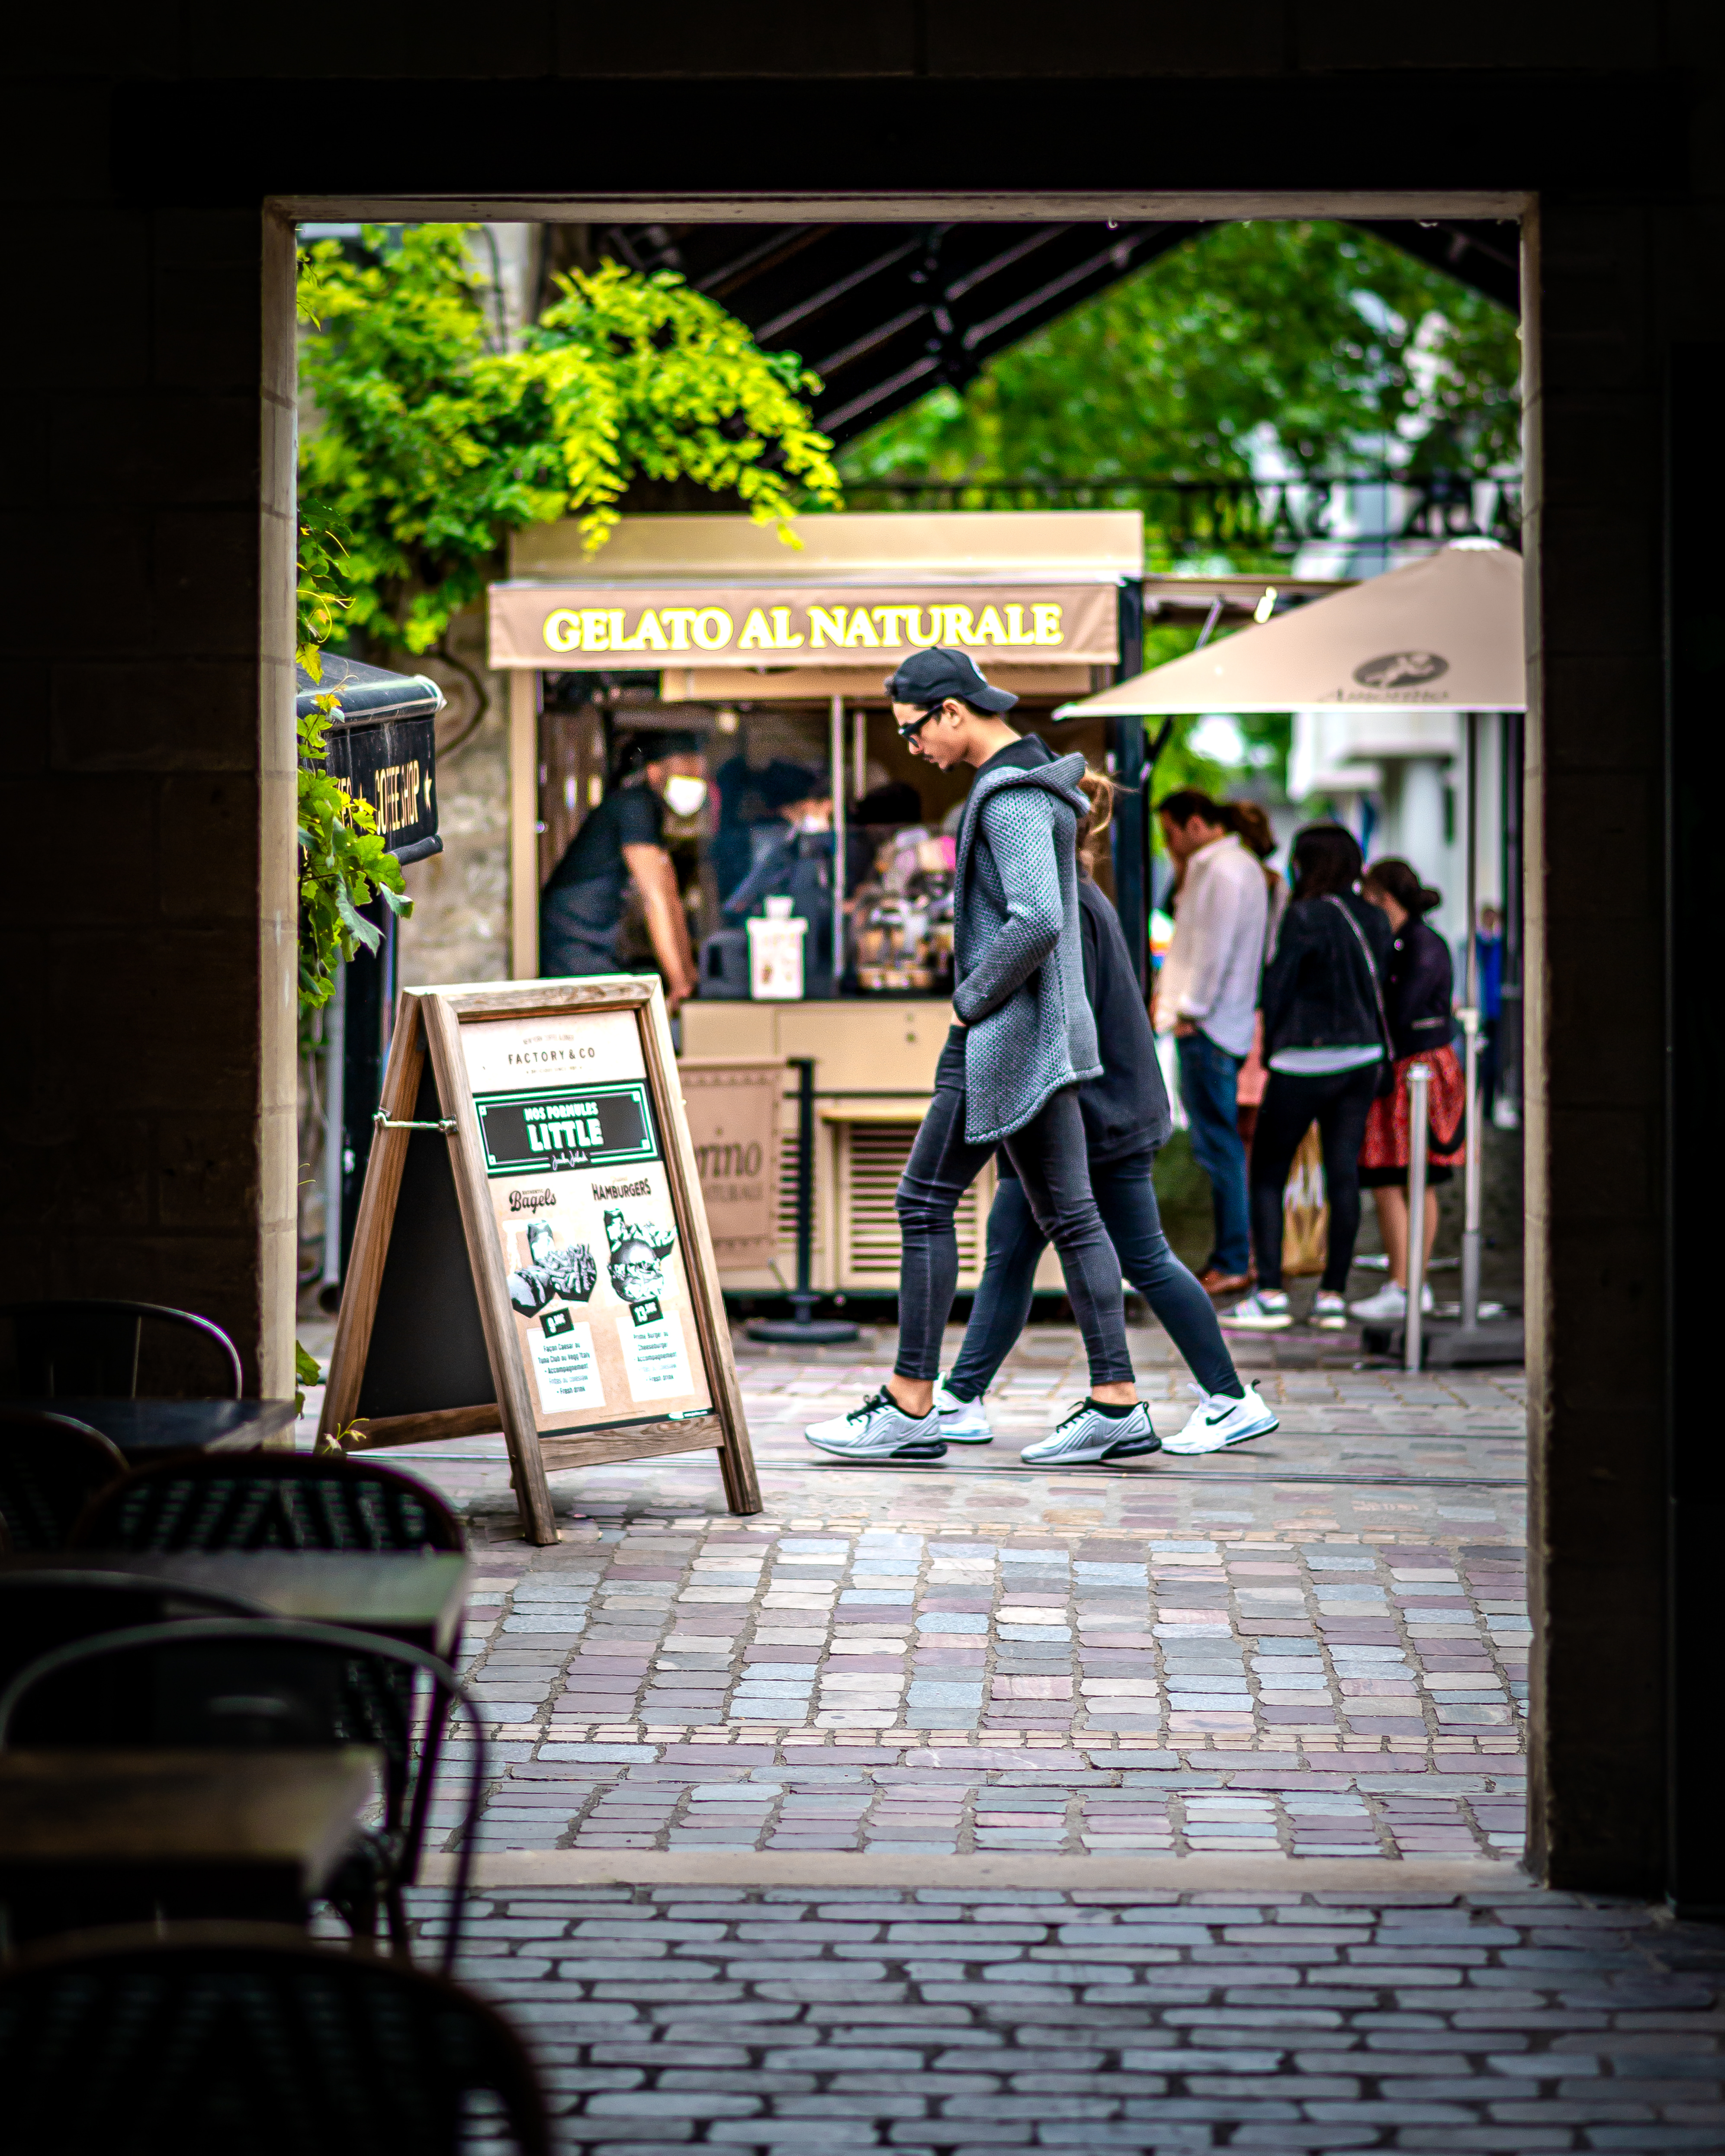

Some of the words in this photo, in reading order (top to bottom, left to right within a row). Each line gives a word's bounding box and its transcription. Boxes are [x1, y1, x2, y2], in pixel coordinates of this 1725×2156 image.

[543, 606, 733, 652] GELATO
[738, 606, 805, 649] AL
[808, 603, 1064, 648] NATURALE
[375, 765, 401, 836] COFFEE
[401, 759, 420, 828] SHOP
[508, 1050, 564, 1065] FACTORY
[569, 1049, 576, 1059] &
[579, 1047, 595, 1059] CO
[523, 1106, 546, 1122] NOS
[526, 1117, 604, 1153] LITTLE
[509, 1188, 557, 1214] Bagels
[591, 1177, 652, 1202] HAMBURGERS
[548, 1363, 588, 1374] Accompagnement
